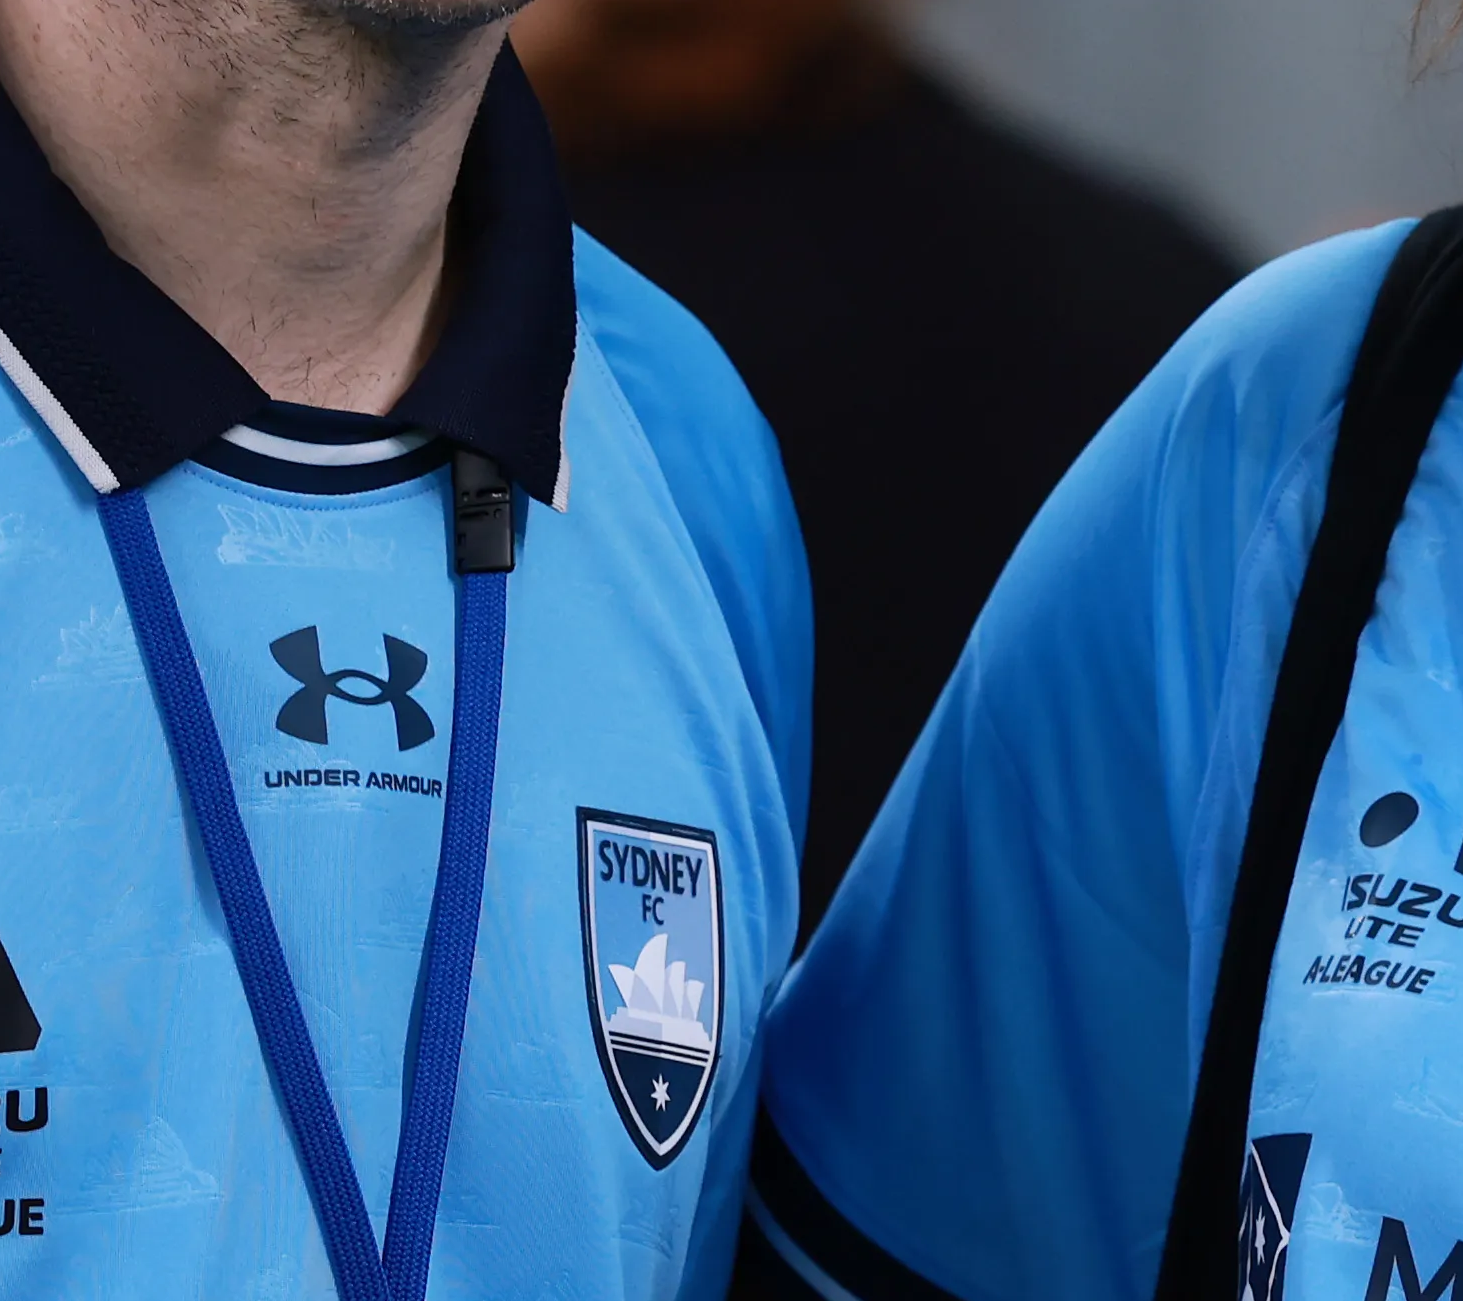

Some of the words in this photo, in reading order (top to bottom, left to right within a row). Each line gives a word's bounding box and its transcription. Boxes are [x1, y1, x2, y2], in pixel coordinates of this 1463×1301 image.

[264, 769, 360, 788] UNDER
[366, 771, 442, 798] ARMOUR
[598, 839, 702, 898] SYDNEY
[641, 893, 665, 926] FC
[1344, 915, 1426, 948] UTE
[1302, 954, 1436, 994] A-LEAGUE
